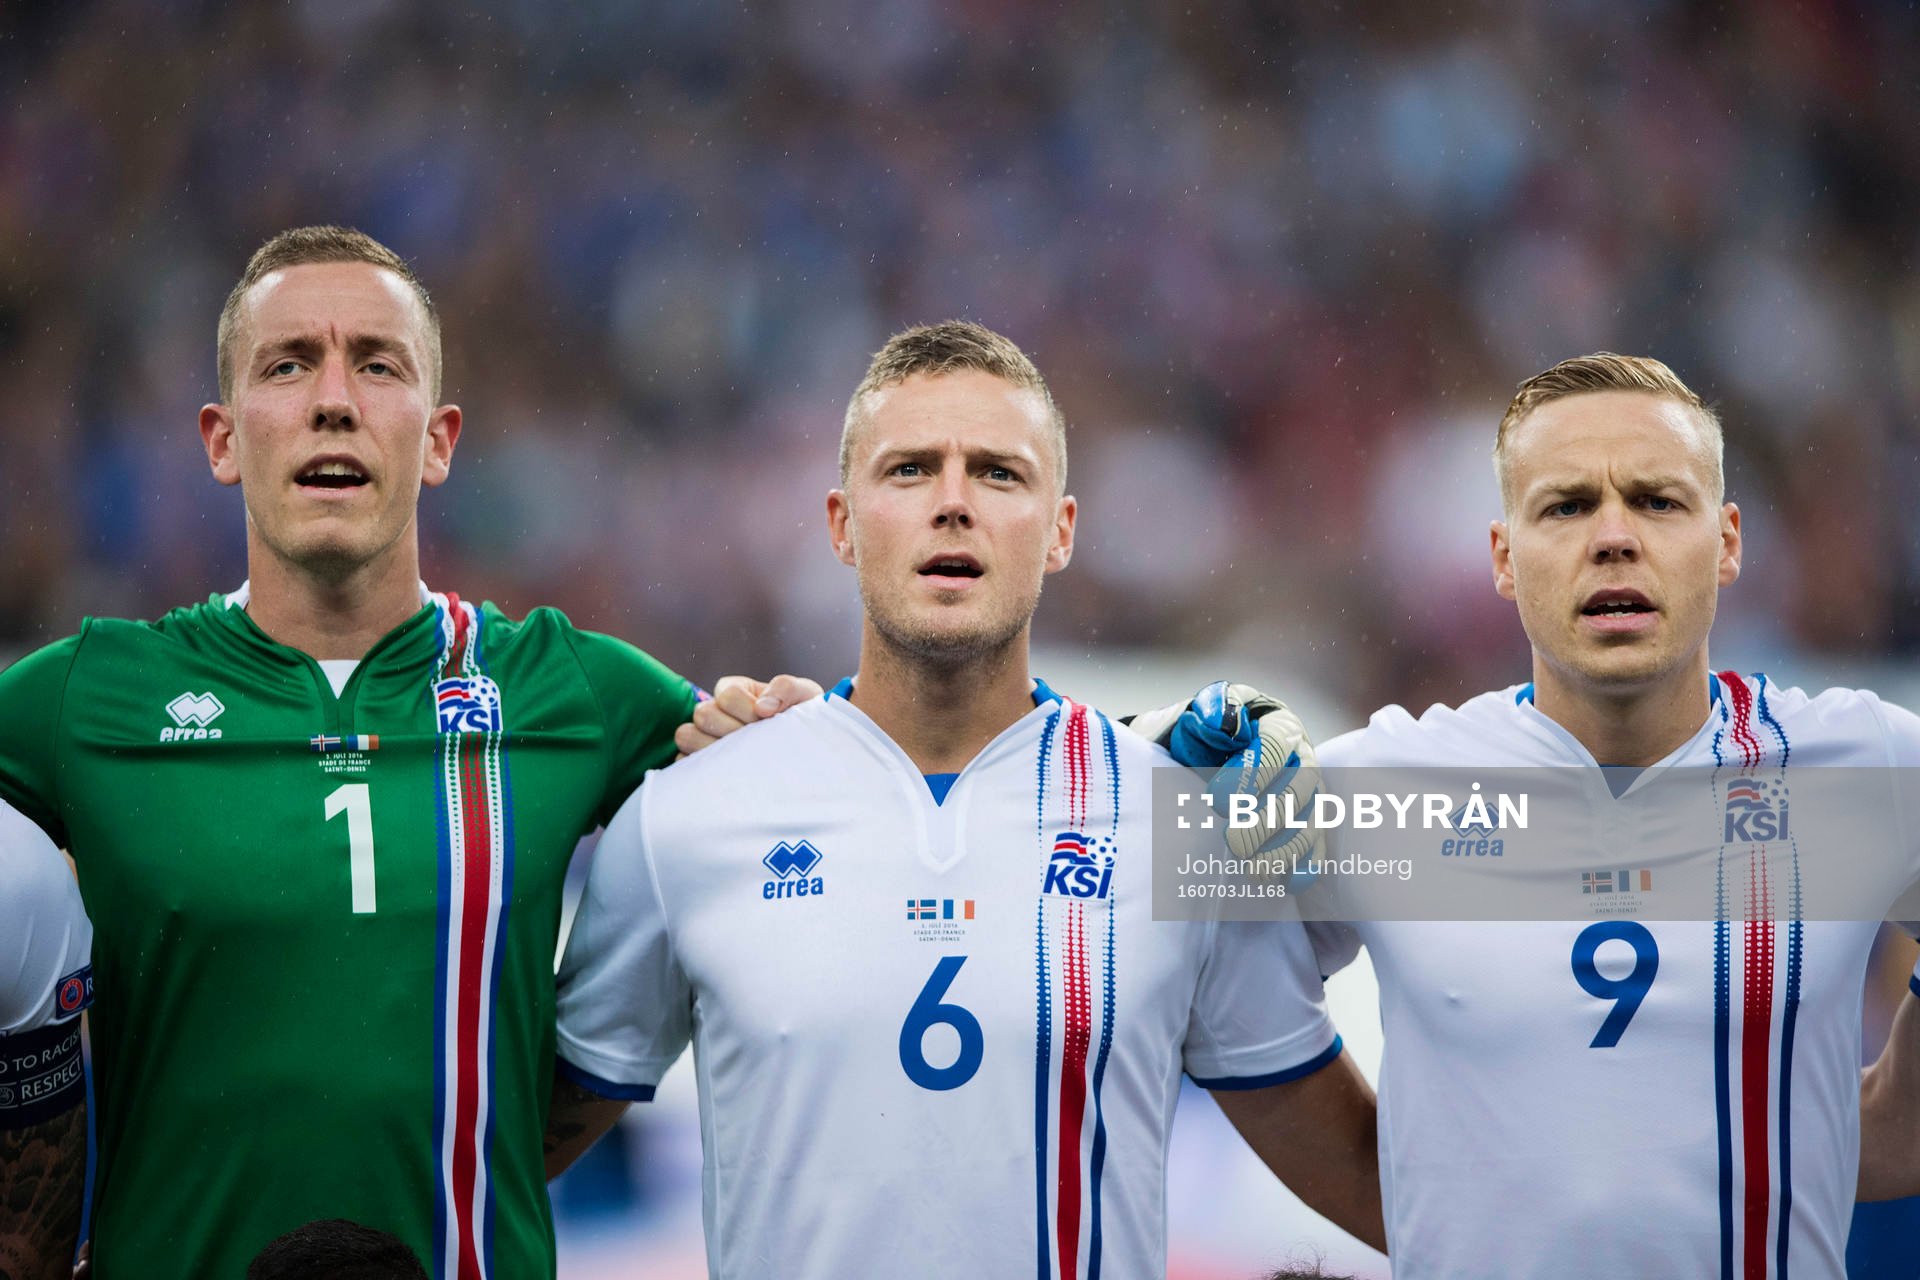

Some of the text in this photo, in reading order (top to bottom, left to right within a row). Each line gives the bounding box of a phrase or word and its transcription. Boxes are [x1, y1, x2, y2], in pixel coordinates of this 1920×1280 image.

[324, 783, 377, 913] 1
[1441, 838, 1504, 856] errea
[763, 877, 823, 899] errea
[1571, 920, 1660, 1049] 9
[899, 956, 984, 1091] 6
[12, 1055, 37, 1072] TO
[21, 1055, 81, 1100] RESPECT
